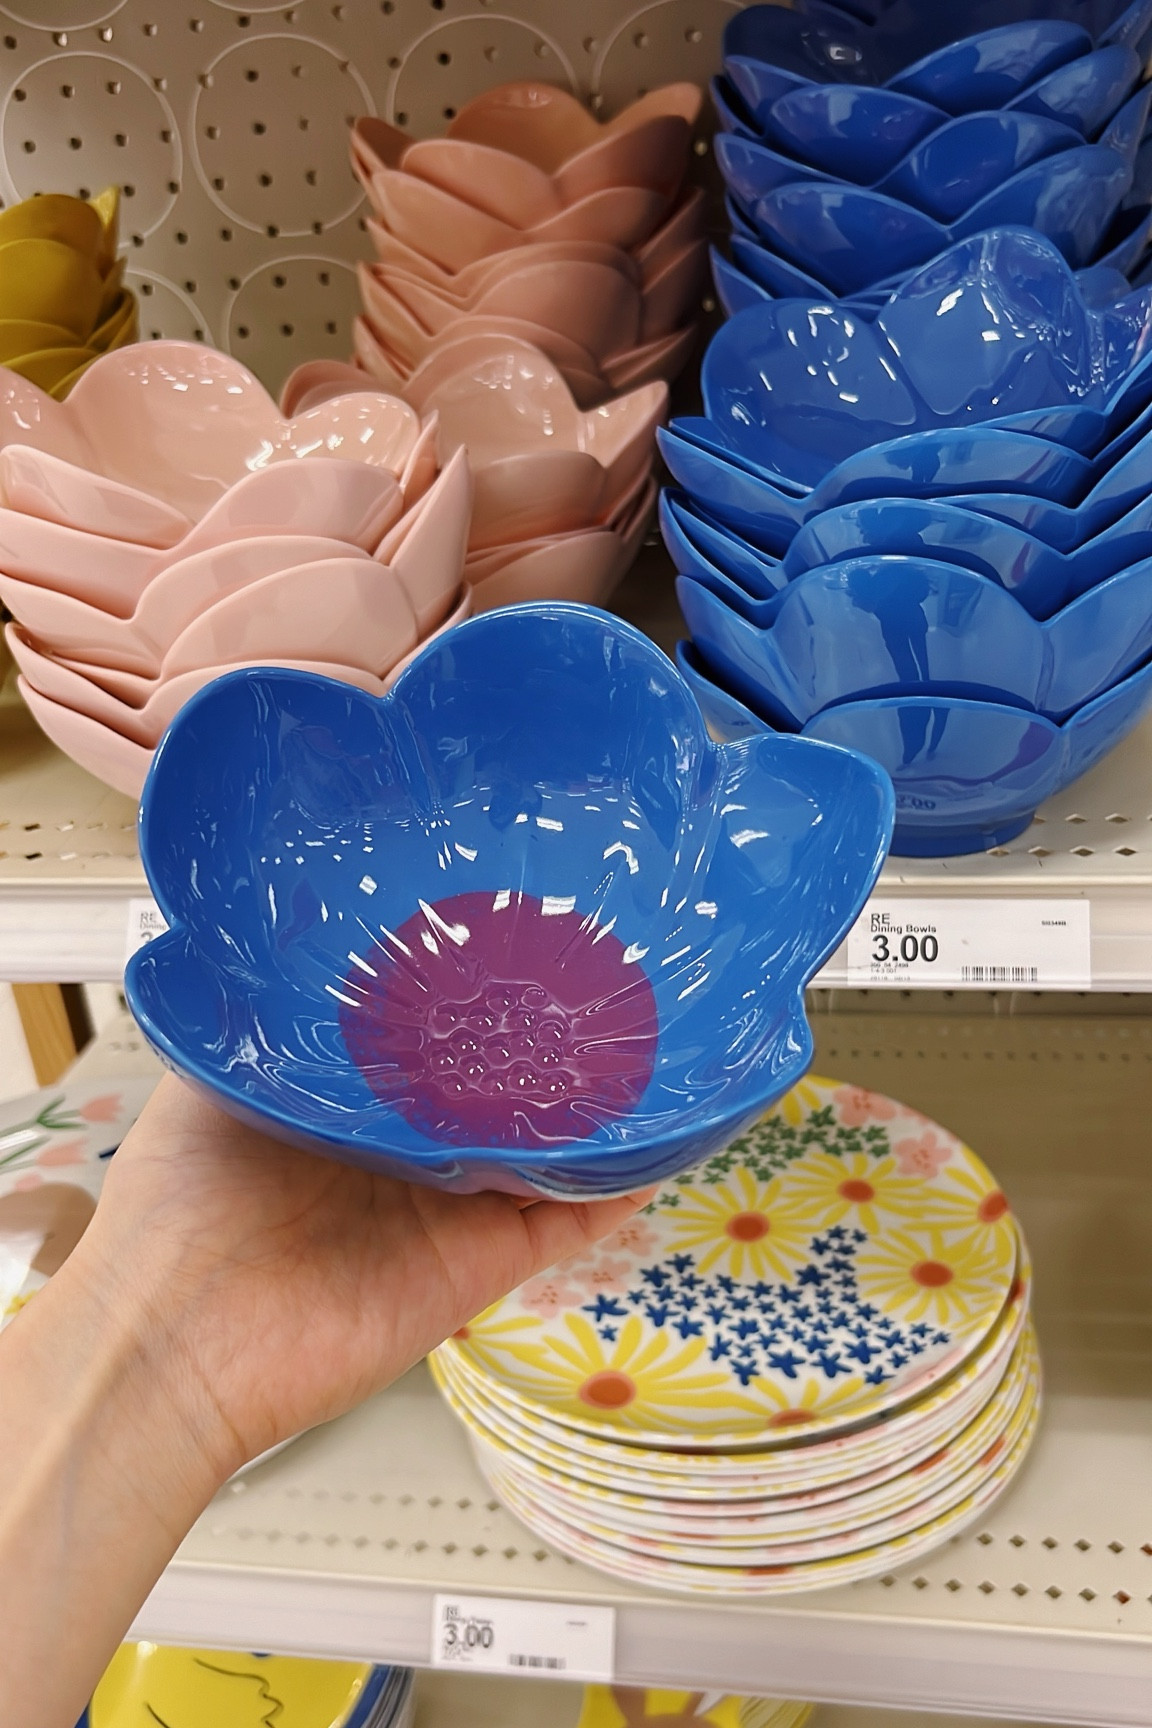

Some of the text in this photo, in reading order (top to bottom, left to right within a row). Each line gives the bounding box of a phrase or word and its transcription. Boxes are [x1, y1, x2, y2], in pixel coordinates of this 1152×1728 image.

[871, 912, 890, 925] RE
[870, 924, 937, 934] Dining Bowls
[871, 934, 939, 962] 3.00
[444, 1623, 494, 1649] 3.00
